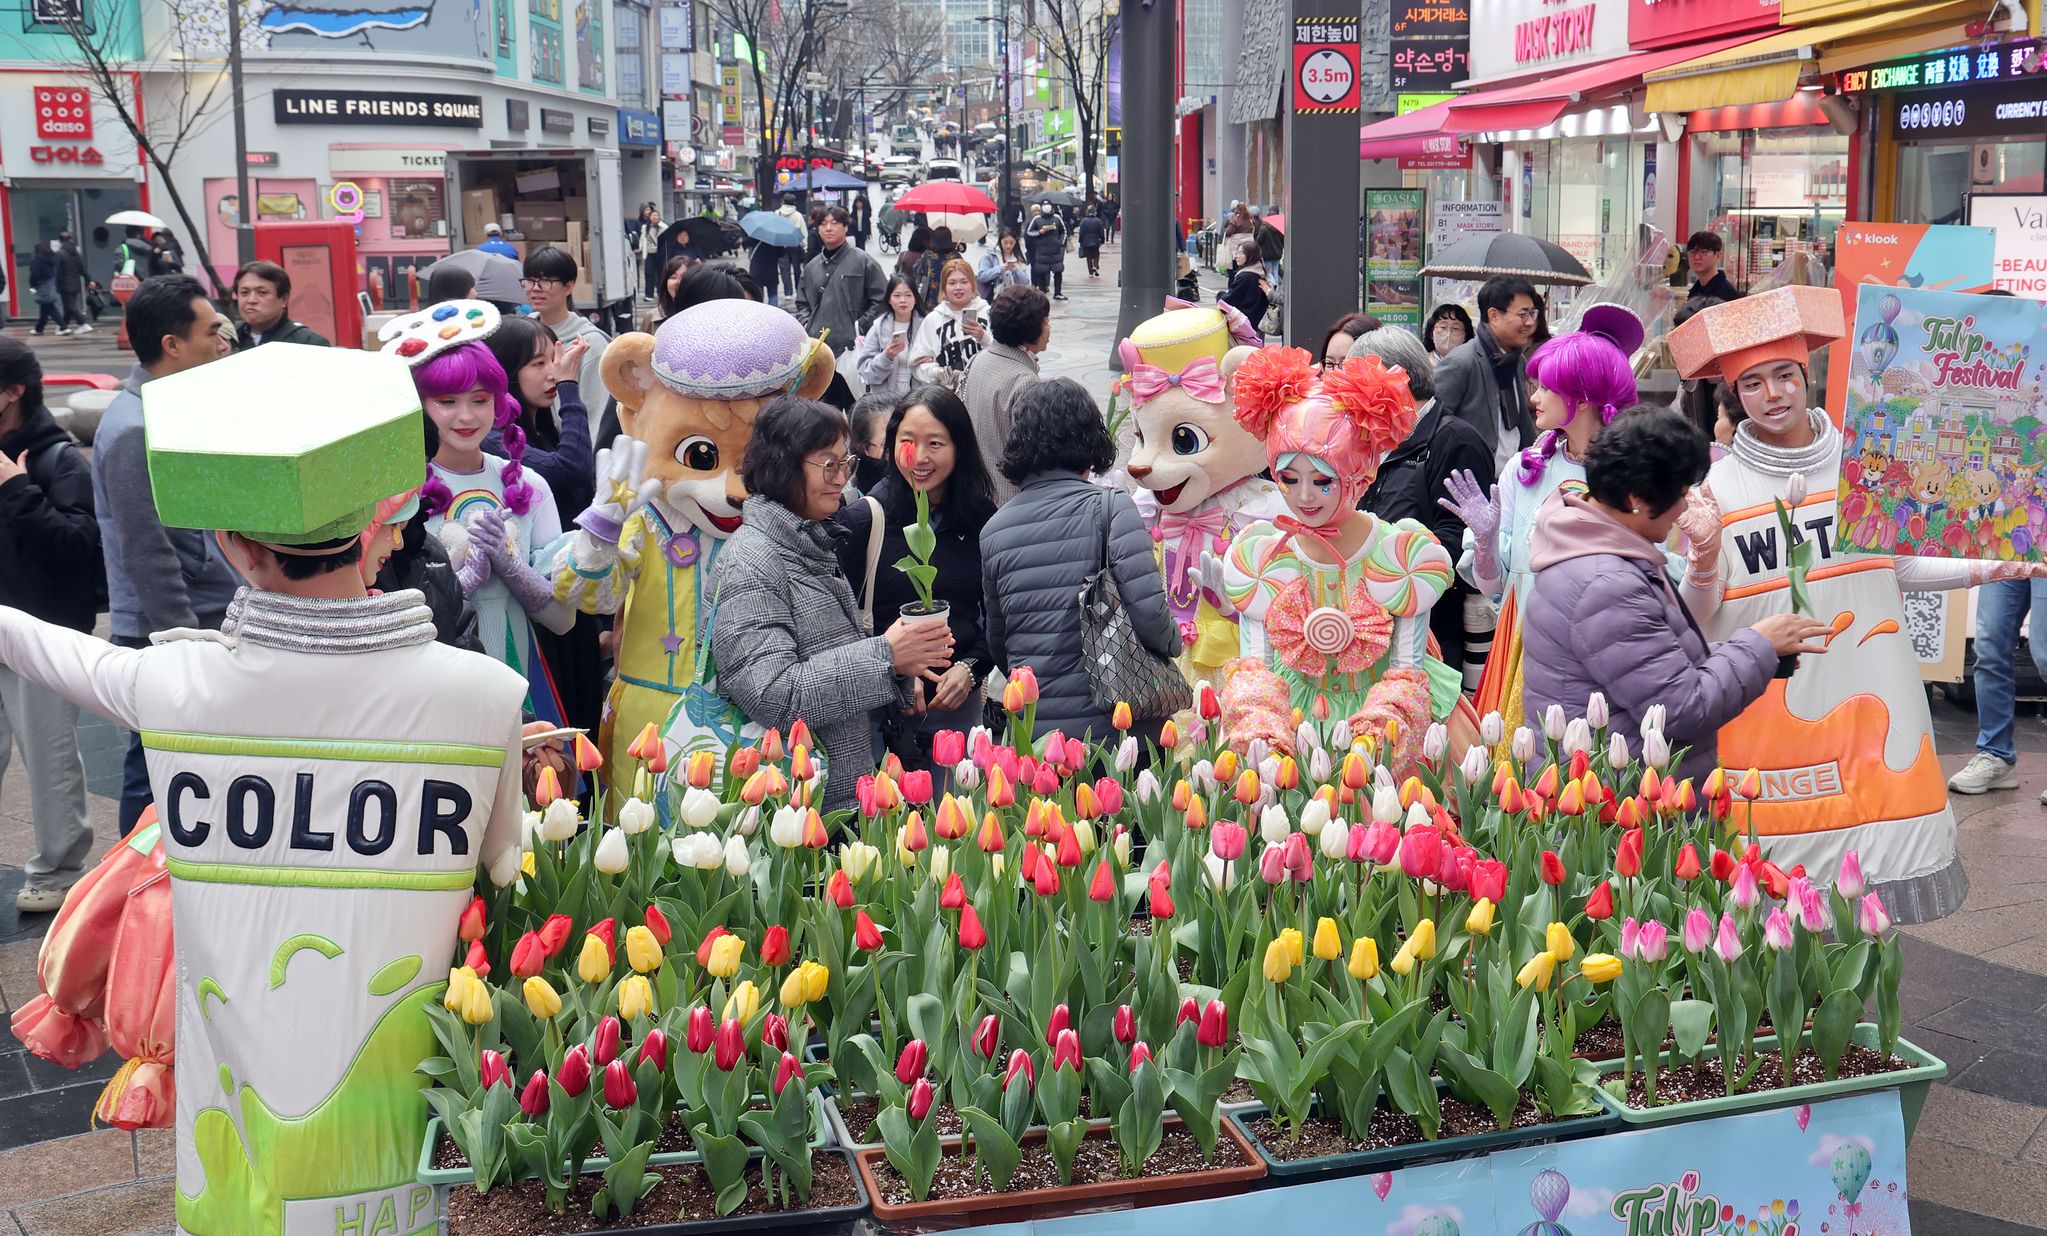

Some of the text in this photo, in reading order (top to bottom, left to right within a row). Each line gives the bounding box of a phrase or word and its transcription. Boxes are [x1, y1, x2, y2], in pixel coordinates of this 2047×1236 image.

[1405, 7, 1468, 22] 시계거래소
[1296, 25, 1358, 43] 제한높이
[1394, 22, 1407, 31] 6F
[1515, 4, 1596, 62] MASK STORY
[1308, 68, 1349, 83] 3.5m
[1394, 77, 1407, 87] 5F
[1871, 63, 1920, 89] EXCHANGE
[286, 98, 481, 119] LINE FRIENDS SQUARE
[1403, 99, 1420, 107] N79
[1995, 101, 2042, 120] CURRENCY
[42, 118, 86, 133] daiso
[30, 145, 104, 166] 다이소
[1383, 193, 1417, 204] OASIA
[1442, 203, 1497, 212] INFORMATION
[1438, 218, 1447, 228] B1
[1438, 234, 1447, 242] 1F
[1864, 232, 1898, 245] klook
[1922, 316, 1985, 362] Tulip
[1932, 351, 2025, 391] Festival
[1734, 515, 1834, 574] WAT
[1725, 766, 1837, 798] RNGE
[167, 771, 473, 857] COLOR
[336, 1186, 439, 1236] HAP
